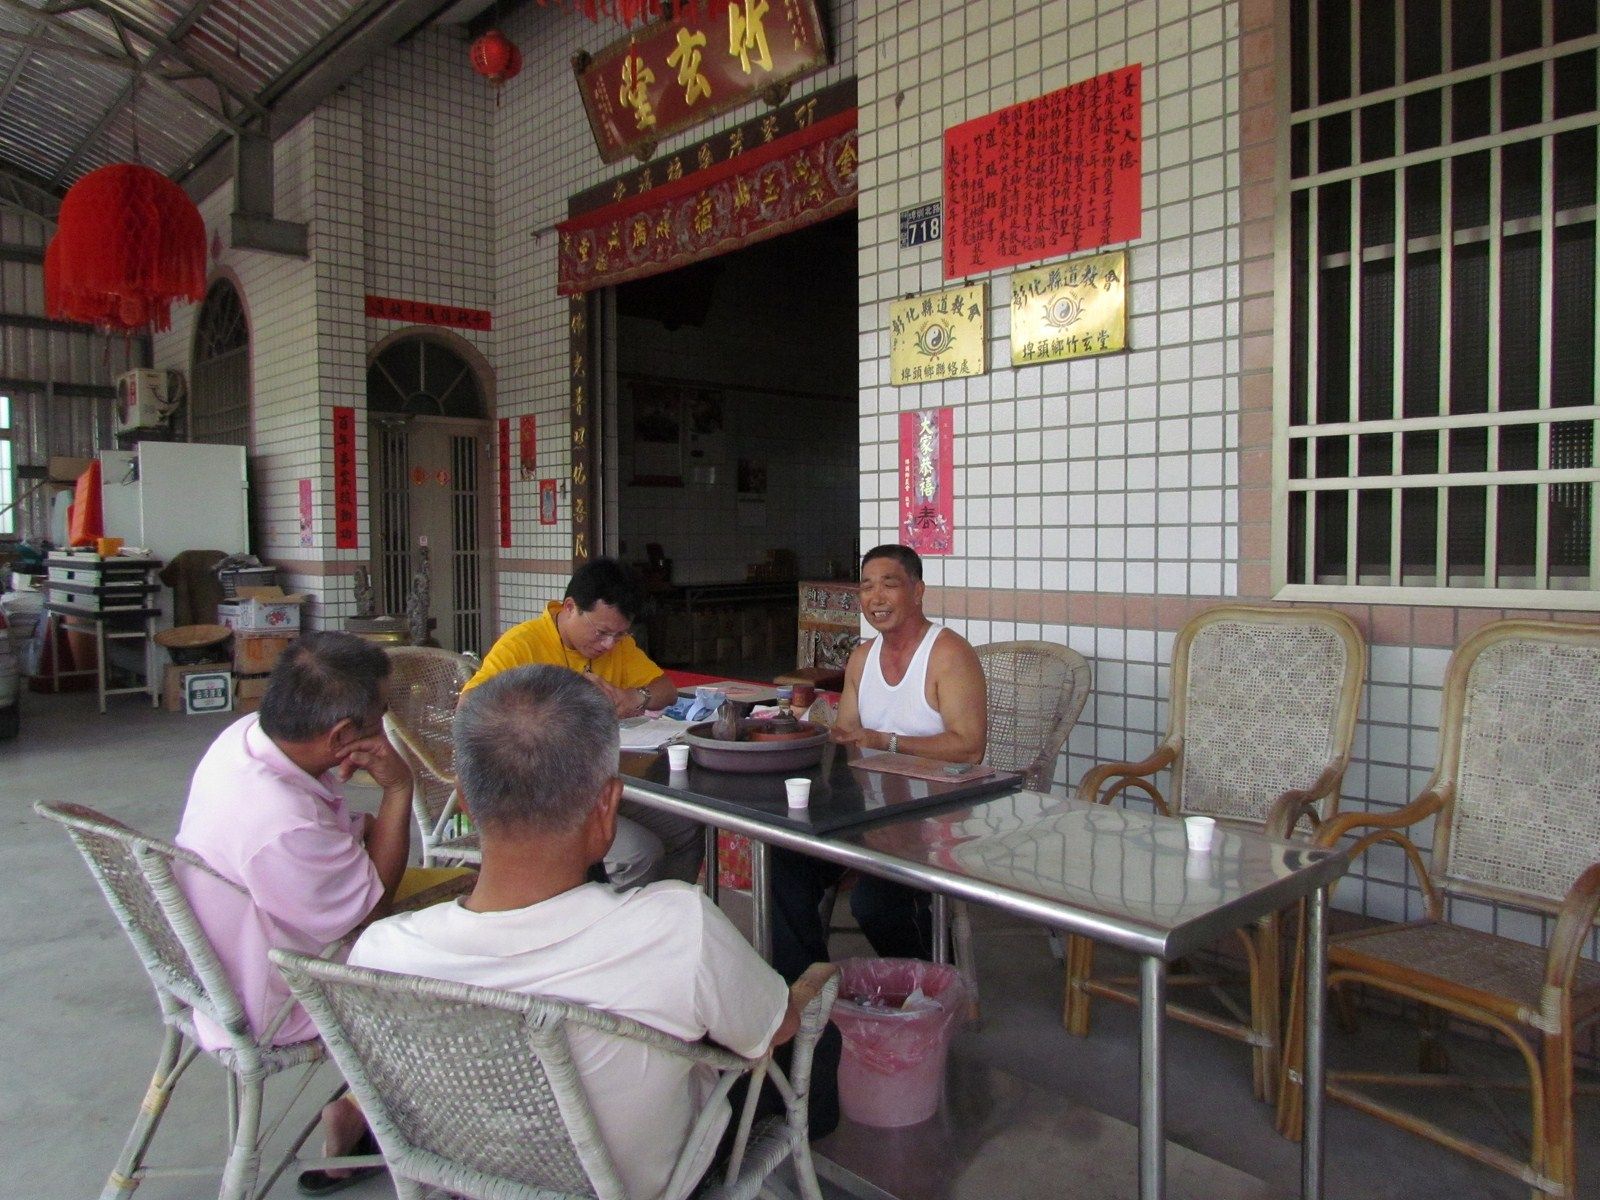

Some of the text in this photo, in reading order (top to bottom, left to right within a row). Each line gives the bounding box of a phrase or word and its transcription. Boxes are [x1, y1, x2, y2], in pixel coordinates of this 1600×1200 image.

[909, 217, 940, 245] 718
[1013, 264, 1120, 310] 彰化縣道教會
[892, 294, 981, 336] 彰化縣道教會
[1022, 329, 1110, 360] 埤頭鄉竹玄堂
[901, 359, 971, 381] 埤頭鄉聯絡處
